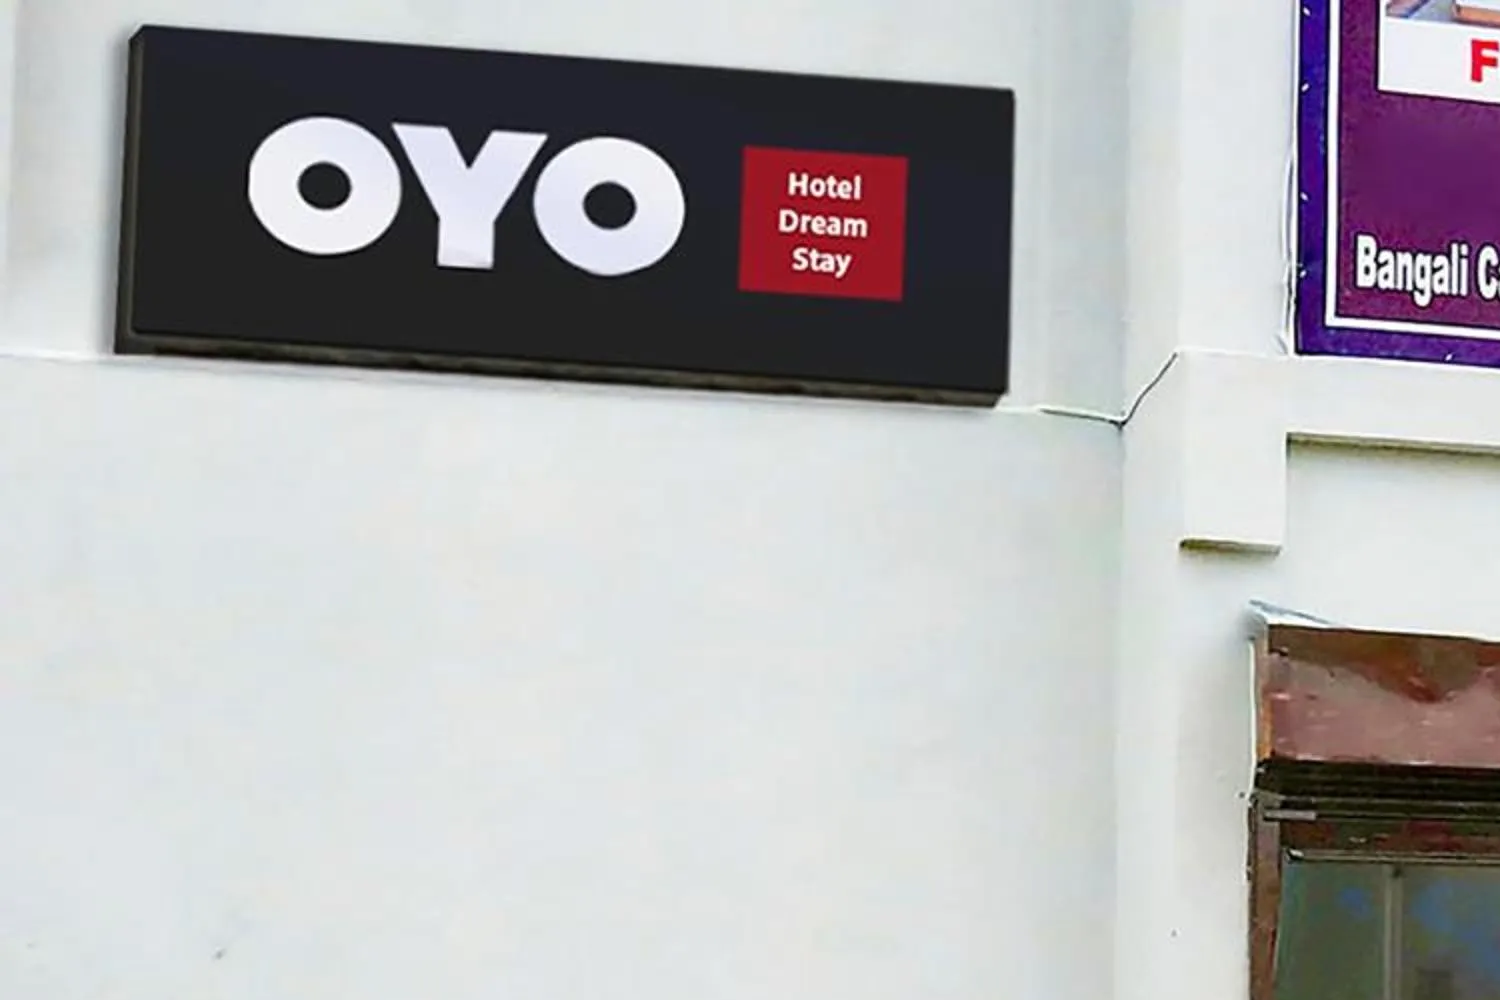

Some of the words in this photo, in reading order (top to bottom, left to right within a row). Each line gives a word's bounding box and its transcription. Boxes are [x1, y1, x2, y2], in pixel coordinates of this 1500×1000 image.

[247, 116, 686, 277] OYO
[787, 171, 862, 200] Hotel
[778, 208, 868, 240] Dream
[792, 246, 853, 279] Stay
[1354, 233, 1469, 308] Bangali
